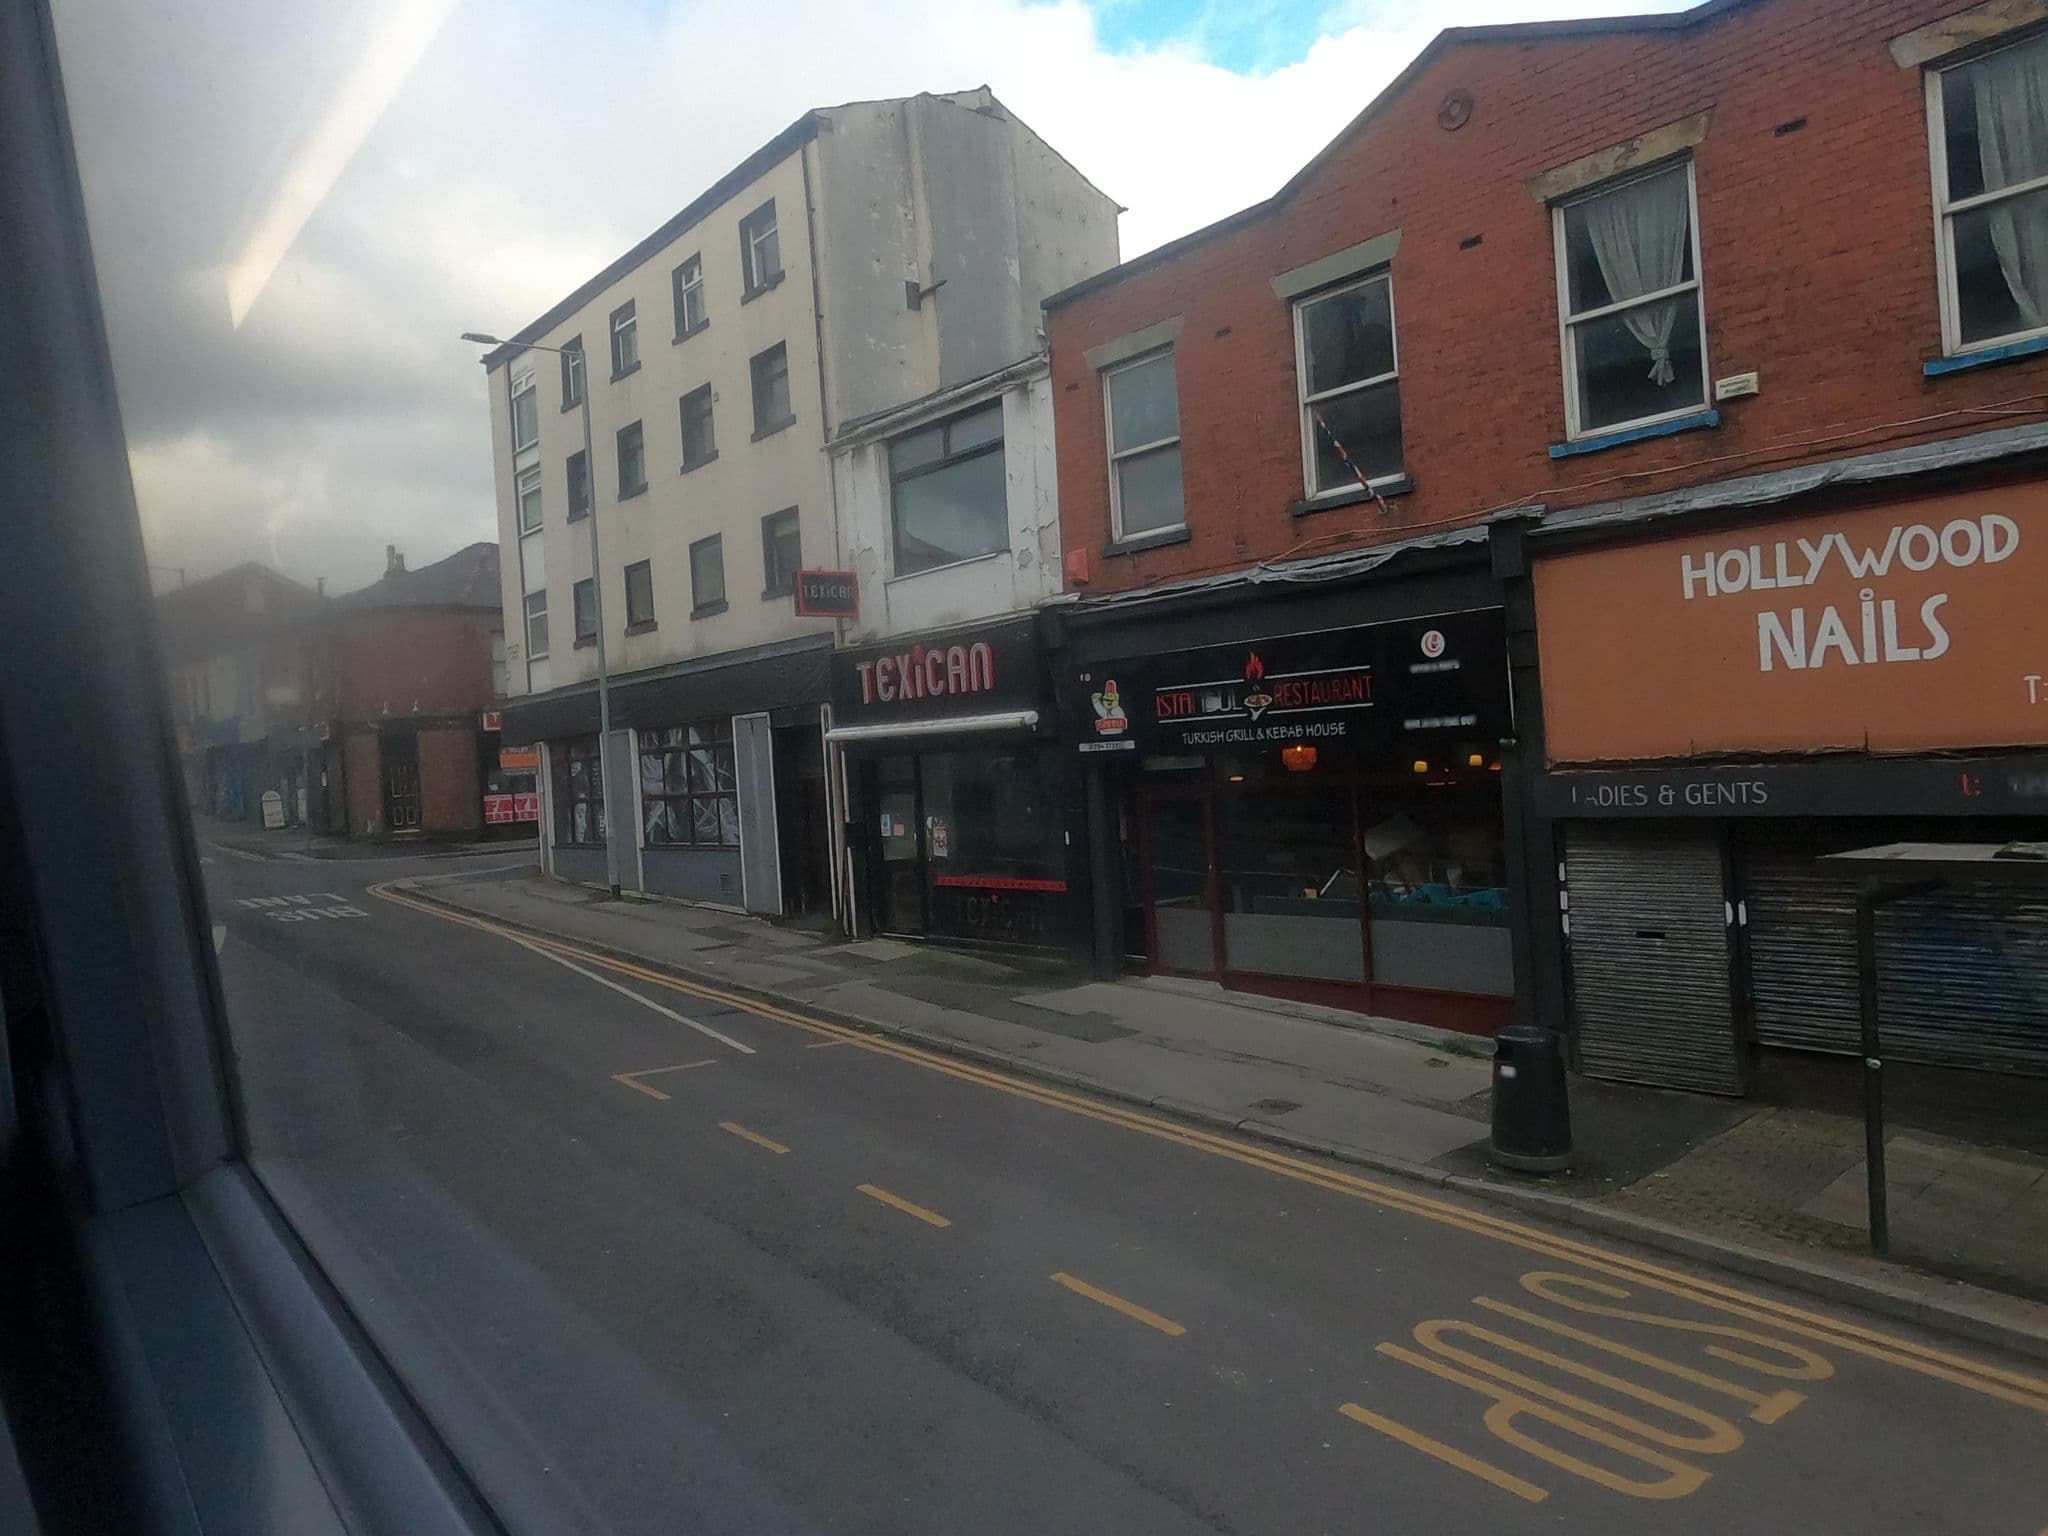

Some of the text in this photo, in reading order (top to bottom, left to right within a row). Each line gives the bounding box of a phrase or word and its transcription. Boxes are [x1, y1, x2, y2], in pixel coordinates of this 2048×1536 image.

[1681, 514, 2020, 600] HOLLYWOOD
[1273, 675, 1374, 707] RESTAURANT
[1182, 721, 1347, 745] TURKISH GRILL & KEBAB HOUSE
[1658, 784, 1675, 806] &
[1685, 781, 1768, 805] GENTS
[1376, 1271, 1835, 1500] STOP
